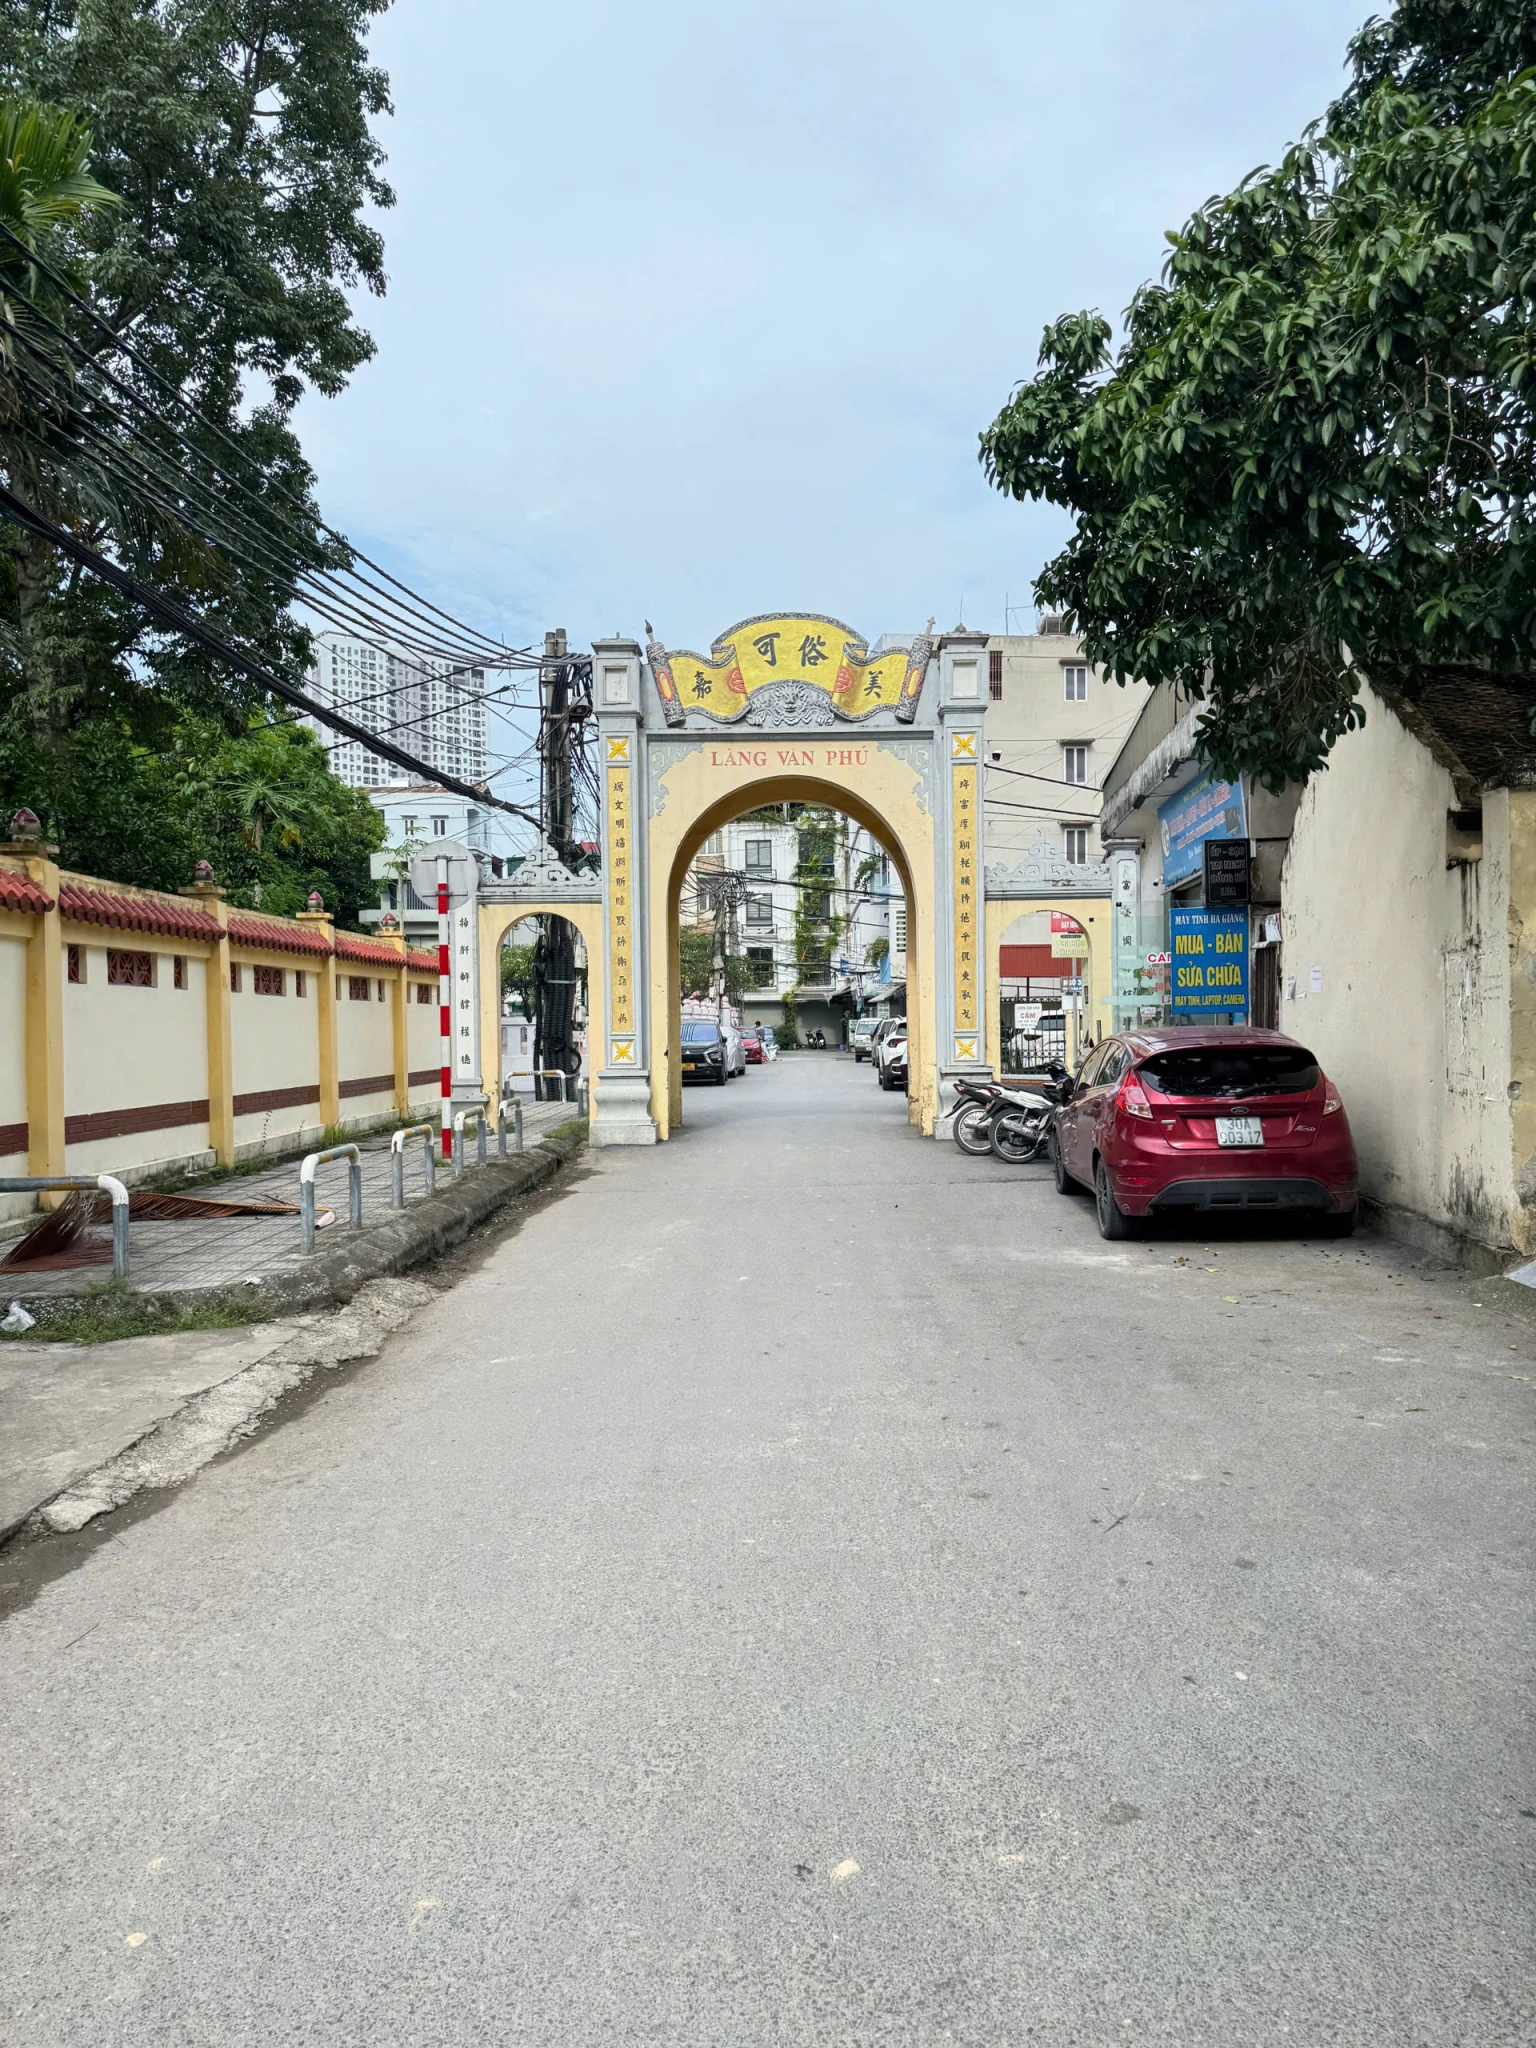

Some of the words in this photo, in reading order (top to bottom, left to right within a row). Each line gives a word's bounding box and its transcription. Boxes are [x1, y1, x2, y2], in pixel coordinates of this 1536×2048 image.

[711, 748, 767, 766] LÀNG
[826, 745, 868, 766] PHÚ
[1175, 914, 1190, 925] MÁY
[1222, 913, 1244, 923] GIANG
[1175, 934, 1204, 954] MUA
[1215, 929, 1243, 953] BÁN
[1177, 961, 1204, 987] SỬA
[1206, 962, 1242, 986] CHỮA
[1227, 1117, 1251, 1130] 30A
[1220, 1131, 1261, 1144] 903.17
